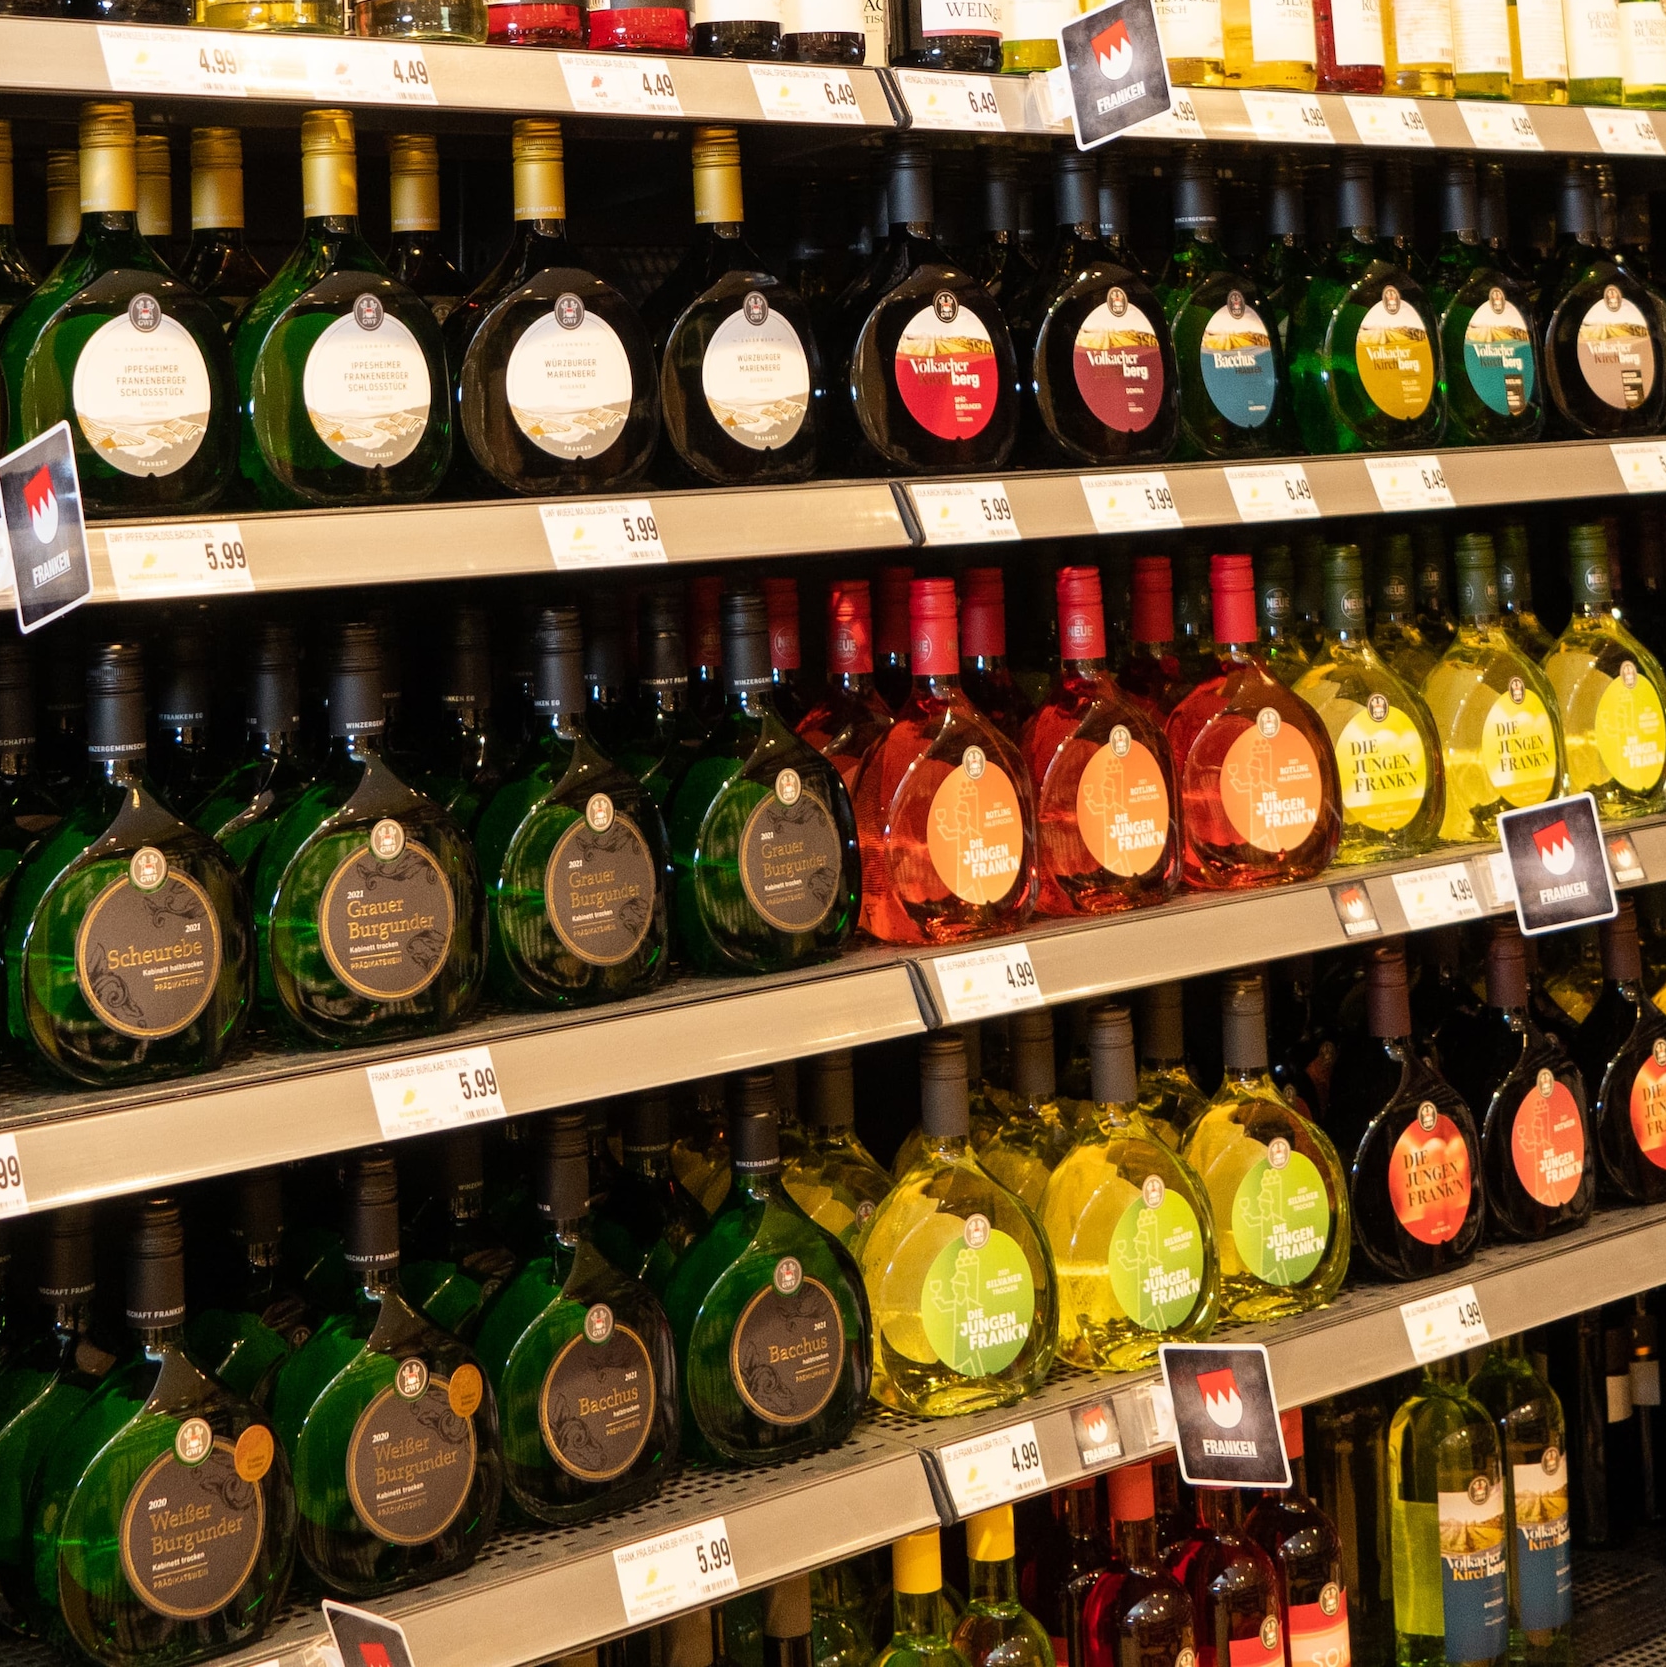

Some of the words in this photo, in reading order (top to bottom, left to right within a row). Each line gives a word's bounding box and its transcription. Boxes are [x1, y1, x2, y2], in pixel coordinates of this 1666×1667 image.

[199, 49, 237, 74] 4.99
[393, 60, 428, 84] 4.49
[642, 73, 674, 96] 4.49
[825, 83, 856, 106] 6.49
[968, 91, 997, 114] 6.49
[1096, 80, 1146, 114] FRANKEN
[1301, 107, 1325, 127] 4.99
[1401, 112, 1423, 130] 4.99
[1511, 116, 1533, 135] 4.99
[1635, 122, 1653, 140] 4.99
[736, 353, 781, 363] WÜRZBURGER
[1086, 351, 1138, 366] Volkacher
[1367, 345, 1411, 362] Volkacher
[1473, 343, 1514, 359] Volkacher
[1587, 341, 1628, 355] Volkacher
[124, 365, 179, 374] IPPESHEIMER
[351, 360, 401, 370] IPPESHEIMER
[544, 358, 597, 368] WÜRZBURGER
[739, 364, 781, 373] MARIENBERG
[909, 358, 969, 374] Volkacher
[1213, 352, 1256, 368] Bacchus
[116, 375, 187, 386] FRANKENBERGER
[344, 371, 409, 382] FRANKENBERGER
[547, 368, 596, 379] MARIENBERG
[120, 386, 185, 397] SCHLOSSSTÜCK
[348, 381, 407, 392] SCHLOSSSTÜCK
[1422, 469, 1446, 490] 6.49
[1145, 488, 1173, 510] 5.99
[1285, 480, 1311, 501] 6.49
[981, 496, 1011, 521] 5.99
[623, 516, 658, 542] 5.99
[205, 540, 246, 570] 5.99
[32, 550, 71, 587] FRANKEN
[1496, 722, 1518, 737] DIE
[1350, 740, 1378, 757] DIE
[1498, 736, 1544, 757] JUNGEN
[1280, 764, 1309, 775] ROTLING
[1352, 754, 1411, 775] JUNGEN
[1500, 751, 1550, 772] FRANK'N
[1354, 771, 1418, 793] FRANK'N
[1256, 797, 1305, 816] JUNGEN
[1109, 819, 1155, 838] JUNGEN
[1265, 808, 1317, 828] FRANK'N
[761, 840, 803, 860] Grauer
[1117, 832, 1166, 851] FRANK'N
[762, 852, 828, 880] Burgunder
[963, 847, 1009, 866] JUNGEN
[971, 856, 1019, 878] FRANK'N
[568, 867, 615, 890] Grauer
[347, 890, 364, 899] 2021
[570, 881, 641, 909] Burgunder
[1539, 881, 1589, 905] FRANKEN
[346, 896, 404, 919] Grauer
[185, 923, 201, 933] 2021
[348, 912, 435, 941] Burgunder
[107, 937, 203, 971] Scheurebe
[349, 944, 376, 955] Kabinett
[377, 941, 399, 951] trocken
[1007, 963, 1035, 989] 4.99
[459, 1067, 498, 1102] 5.99
[1406, 1160, 1459, 1188] JUNGEN
[1408, 1184, 1465, 1207] FRANK'N
[1266, 1230, 1314, 1250] JUNGEN
[1275, 1240, 1325, 1261] FRANK'N
[986, 1274, 1023, 1289] SILVANER
[1142, 1271, 1191, 1294] JUNGEN
[1151, 1282, 1200, 1306] FRANK'N
[967, 1309, 984, 1321] DIE
[1458, 1304, 1481, 1327] 4.99
[960, 1315, 1016, 1337] JUNGEN
[968, 1326, 1029, 1351] FRANK'N
[768, 1335, 828, 1365] Bacchus
[578, 1386, 639, 1417] Bacchus
[372, 1436, 430, 1461] Weißer
[1012, 1441, 1039, 1473] 4.99
[1084, 1443, 1120, 1463] FRANKEN
[1202, 1439, 1258, 1457] FRANKEN
[374, 1447, 458, 1486] Burgunder
[149, 1498, 167, 1510] 2020
[149, 1503, 212, 1533] Weißer
[150, 1515, 243, 1556] Burgunder
[697, 1538, 732, 1575] 5.99
